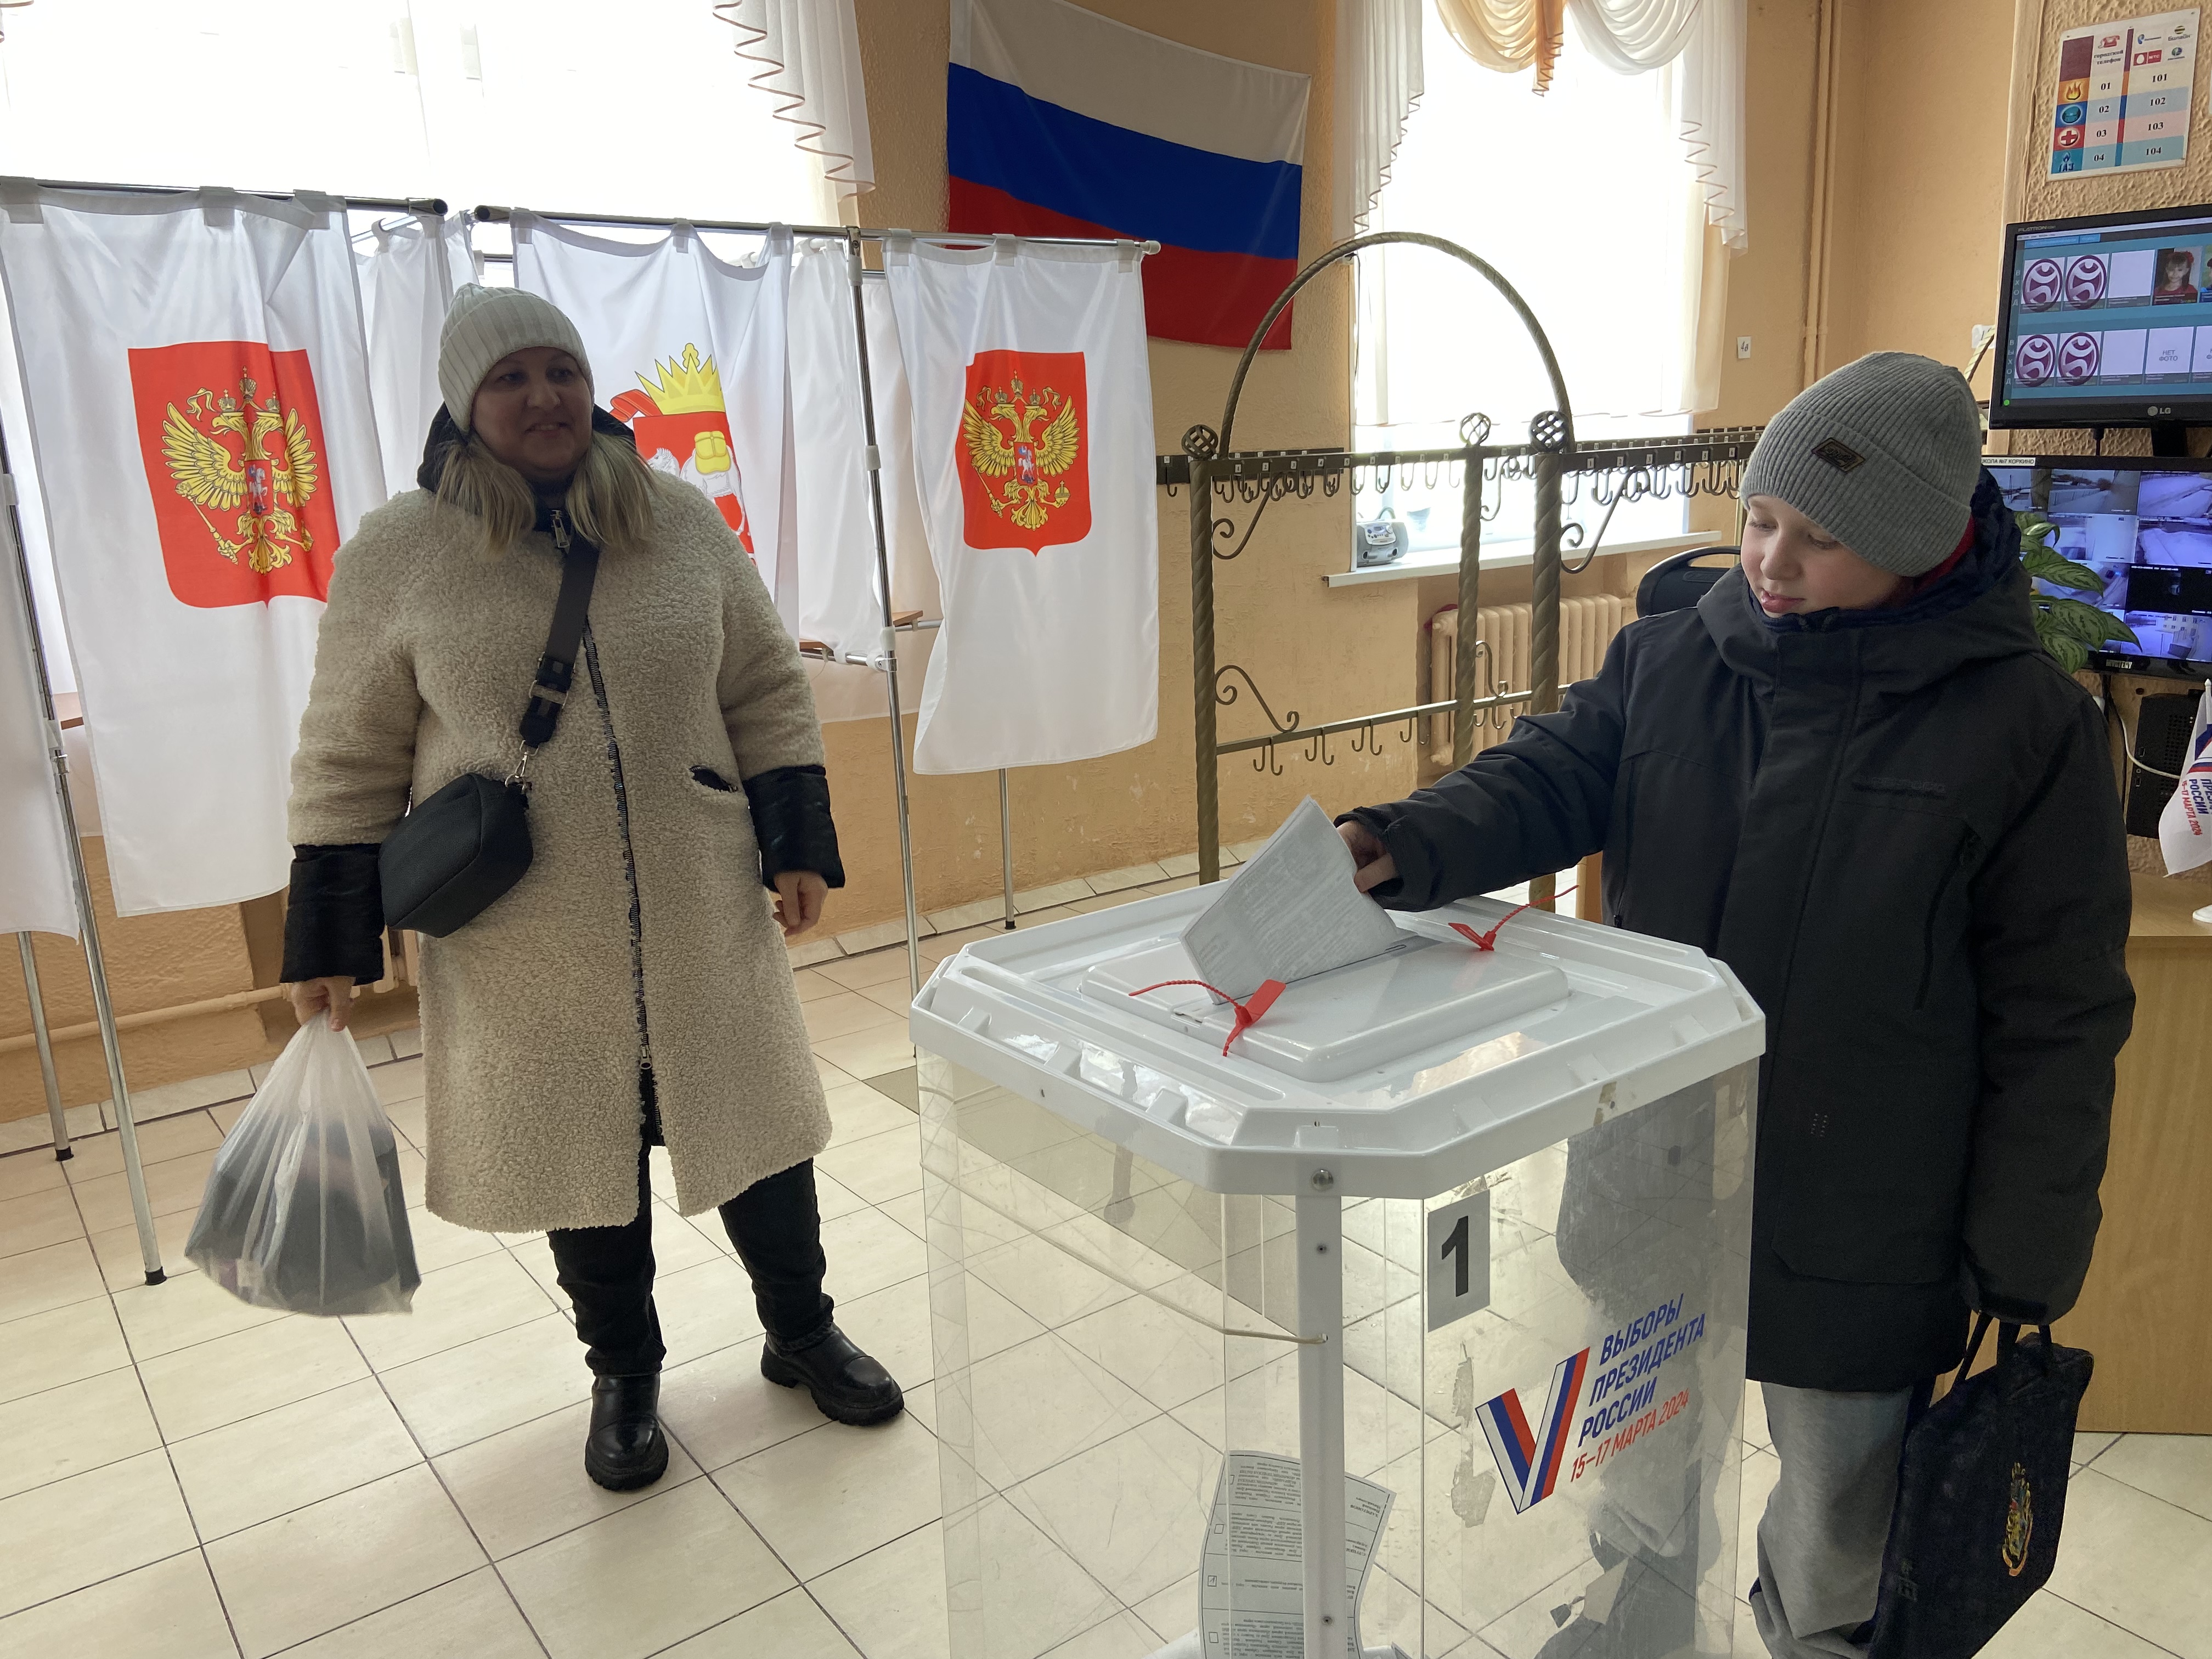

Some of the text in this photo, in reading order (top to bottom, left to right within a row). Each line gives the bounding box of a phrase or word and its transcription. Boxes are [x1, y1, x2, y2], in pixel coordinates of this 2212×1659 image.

[2152, 73, 2168, 83] 101
[2098, 105, 2109, 114] 02
[2149, 97, 2166, 106] 102
[2147, 122, 2164, 131] 103
[2145, 146, 2162, 155] 104
[2188, 778, 2209, 814] РОССИИ
[2182, 797, 2197, 819] МАРТА
[2188, 820, 2203, 836] 2024
[1441, 1215, 1469, 1297] 1
[1599, 1293, 1684, 1366] ВЫБОРЫ
[1588, 1312, 1706, 1407] ПРЕЗИДЕНТА
[1577, 1375, 1658, 1448] РОССИИ
[1610, 1408, 1657, 1457] МАРТА
[1657, 1387, 1690, 1426] 2024
